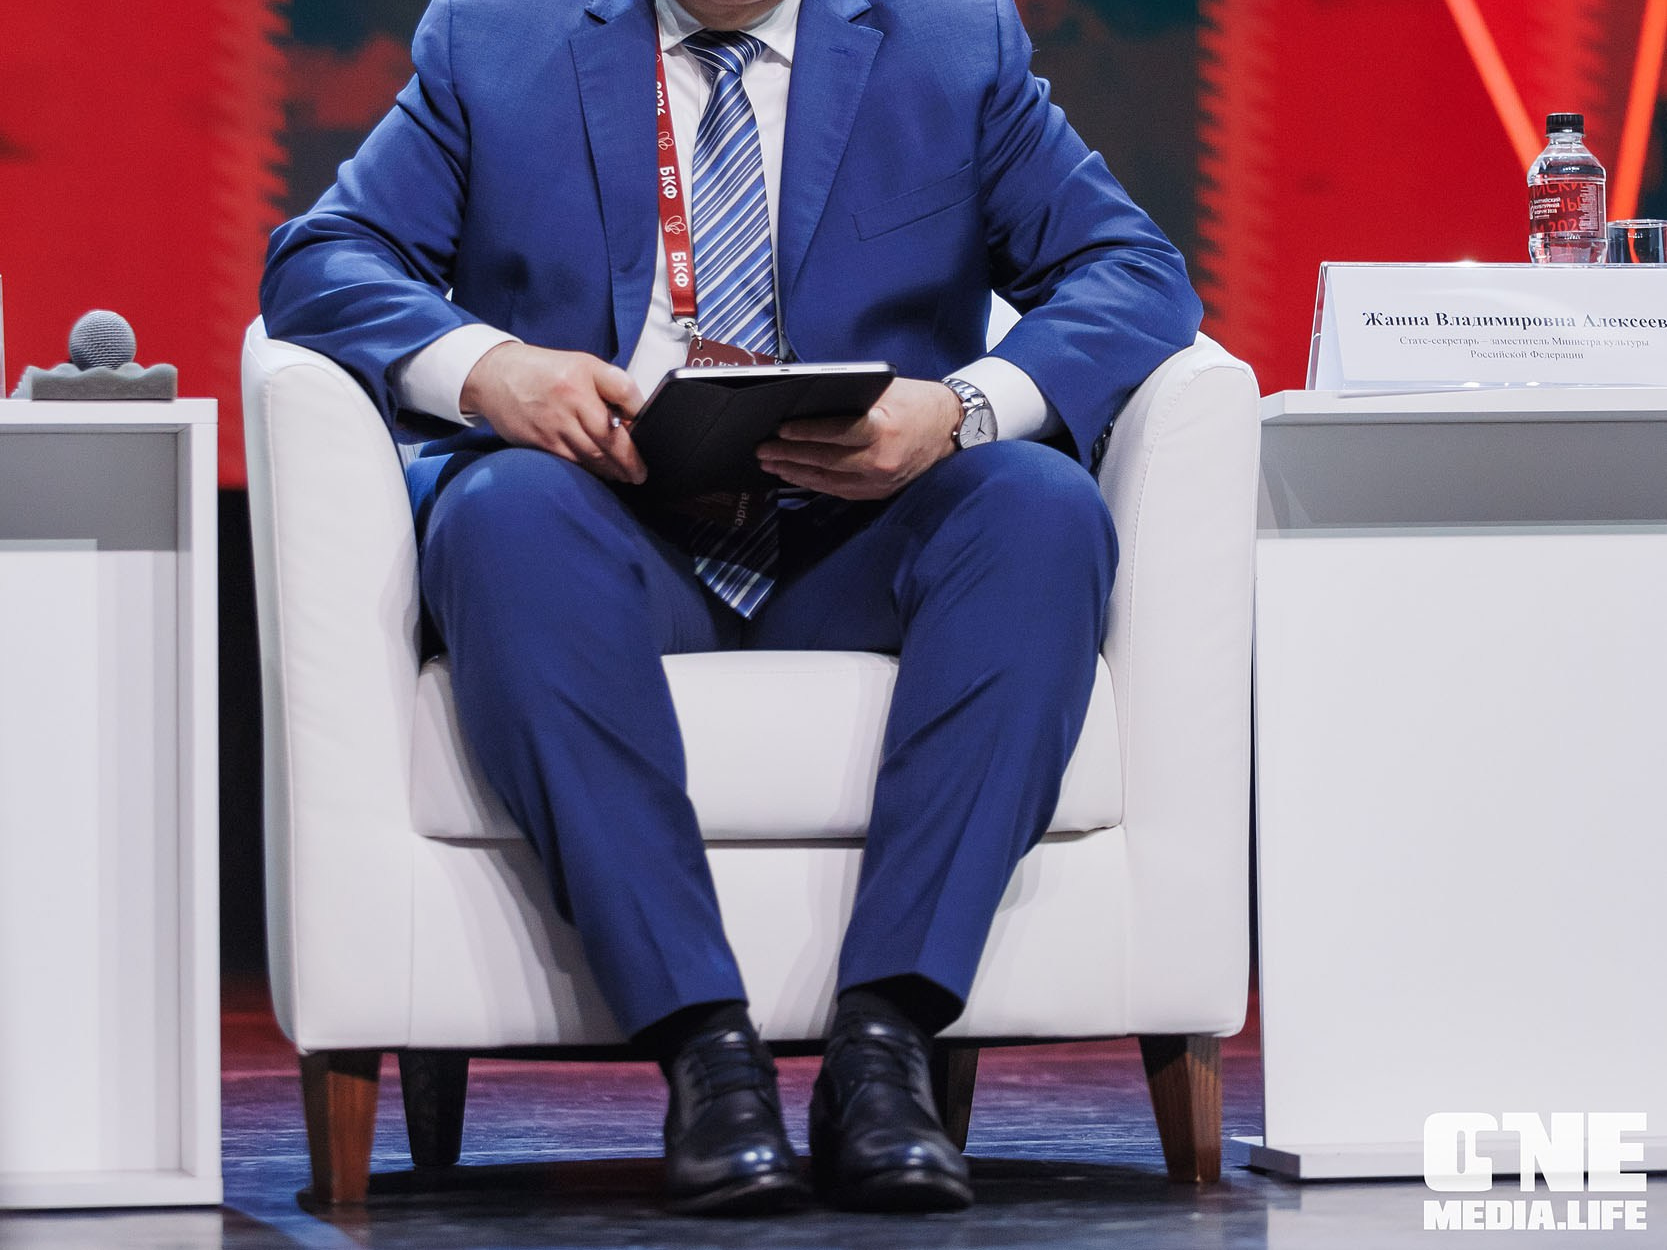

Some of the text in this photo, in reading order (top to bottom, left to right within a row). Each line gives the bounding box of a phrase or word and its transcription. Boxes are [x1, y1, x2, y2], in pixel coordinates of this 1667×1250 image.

[659, 165, 677, 200] БКФ
[670, 251, 690, 288] БКФ
[1362, 312, 1667, 331] Жанна Владимировна Алексеев
[1399, 336, 1480, 347] Статс-секретарь
[1492, 337, 1550, 347] заместитель
[1552, 337, 1601, 348] Министра
[1603, 339, 1650, 349] культуры
[1470, 350, 1584, 361] Российской Федерации
